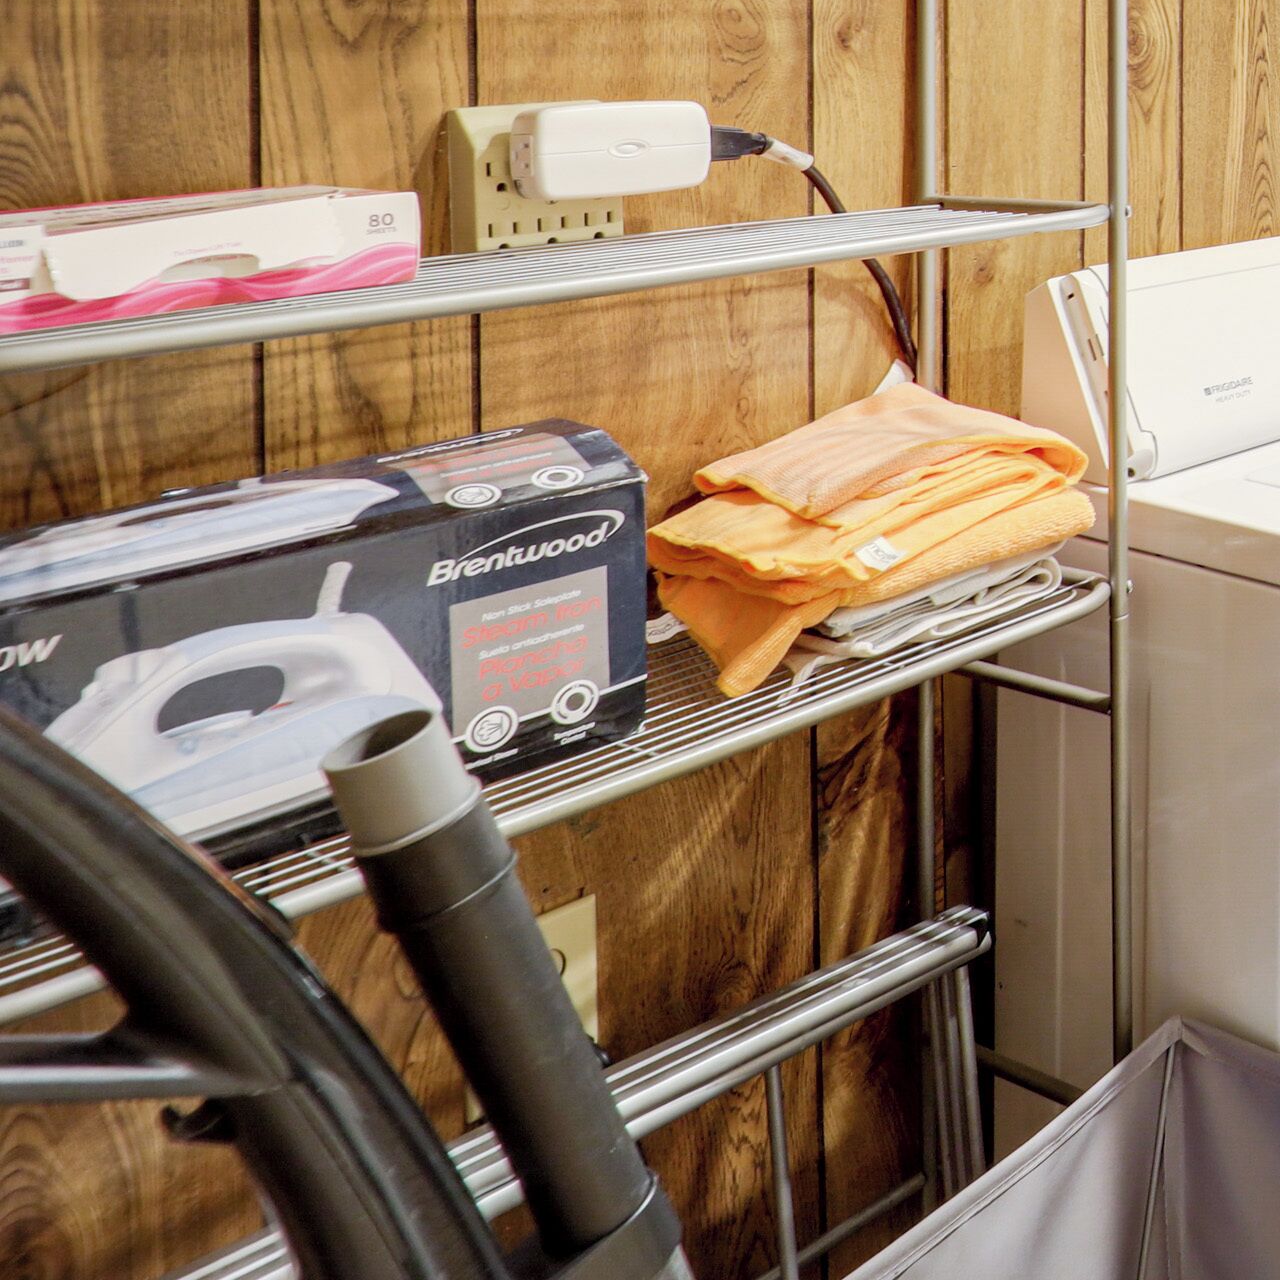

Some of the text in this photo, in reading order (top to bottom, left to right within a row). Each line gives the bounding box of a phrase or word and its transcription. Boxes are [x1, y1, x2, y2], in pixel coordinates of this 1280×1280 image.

[369, 213, 394, 227] 80
[427, 521, 609, 587] Brentwood
[463, 596, 601, 649] Steam Iron
[482, 589, 581, 622] Non Stick Soleplate
[479, 635, 589, 681] Plancha
[482, 656, 586, 702] a Vapor
